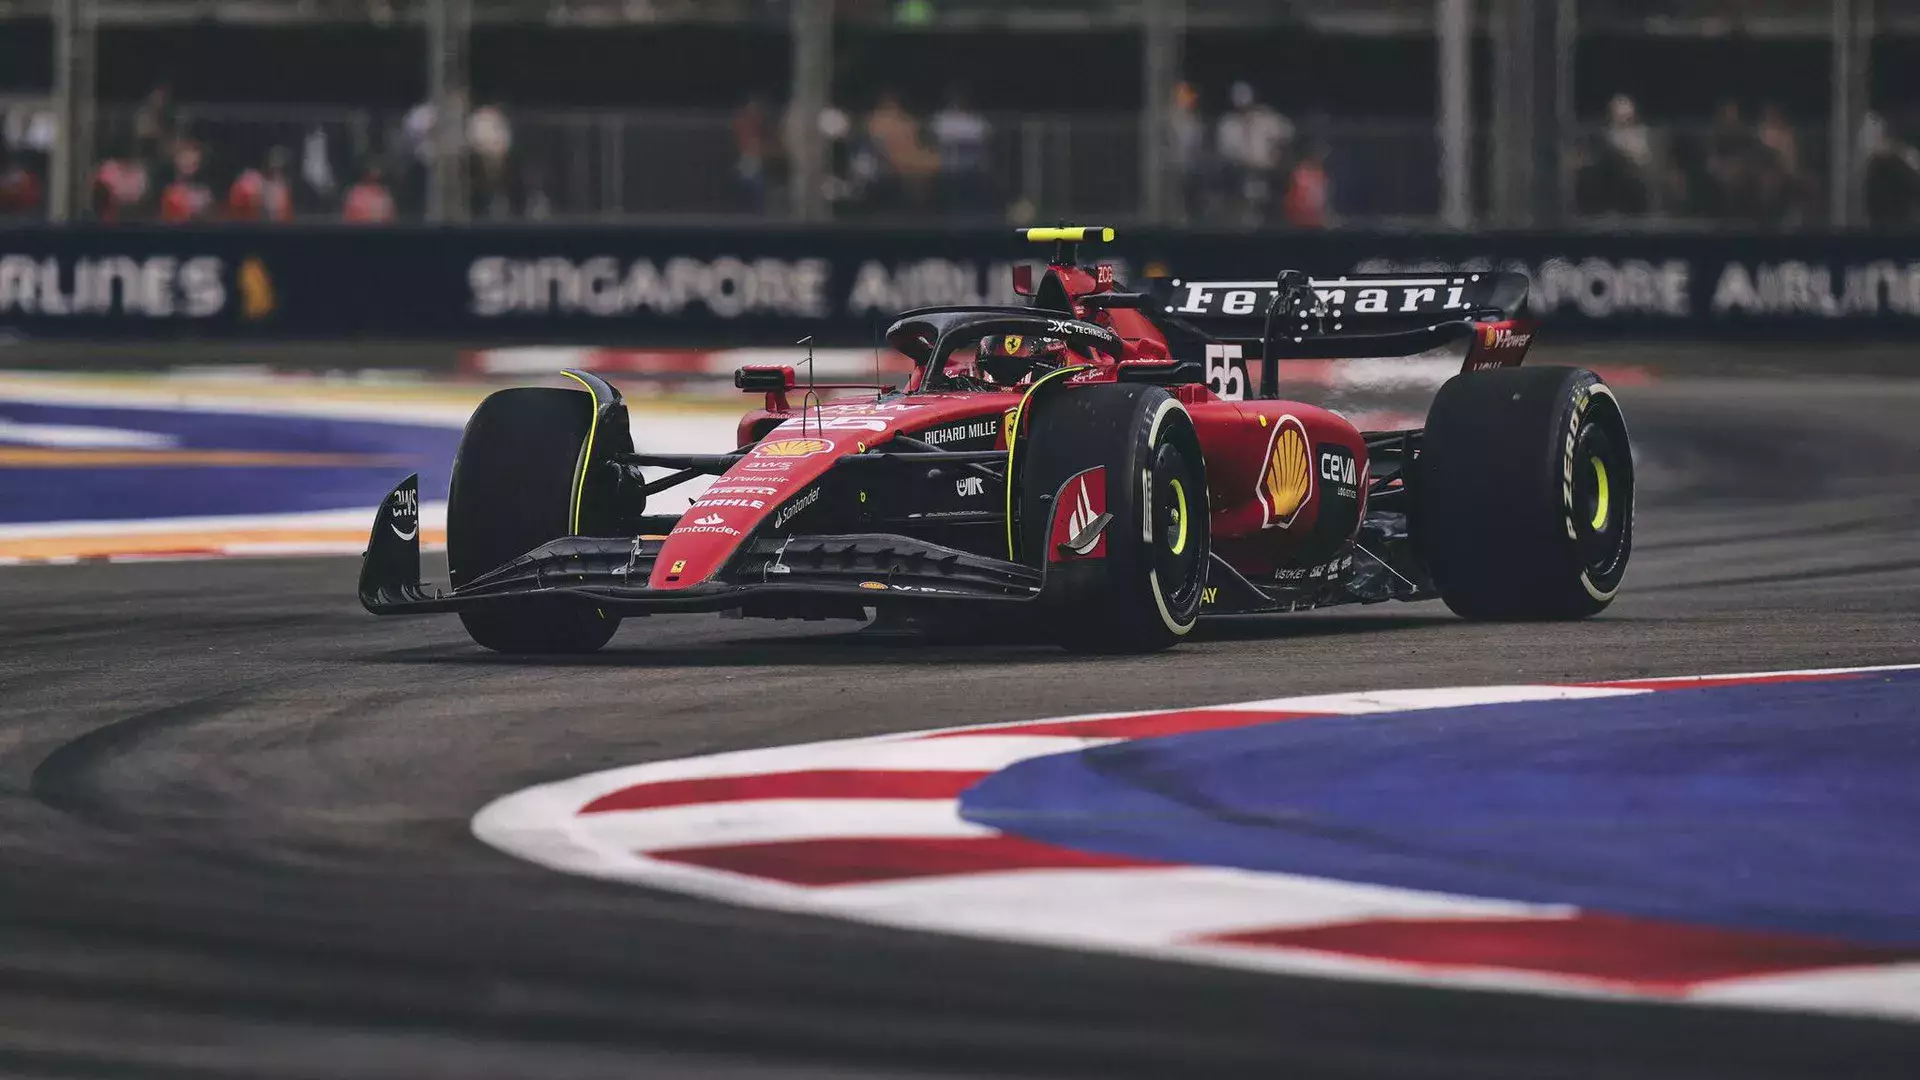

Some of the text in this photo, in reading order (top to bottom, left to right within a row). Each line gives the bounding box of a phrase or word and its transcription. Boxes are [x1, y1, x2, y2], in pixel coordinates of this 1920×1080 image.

[468, 255, 829, 317] SINGAPORE
[1047, 319, 1113, 341] DXC TECHNOLOGY
[1206, 344, 1244, 402] 55
[924, 420, 997, 445] RICHARD MILLE
[1562, 407, 1580, 511] ZERO
[783, 486, 821, 523] Santander
[673, 525, 741, 536] antander
